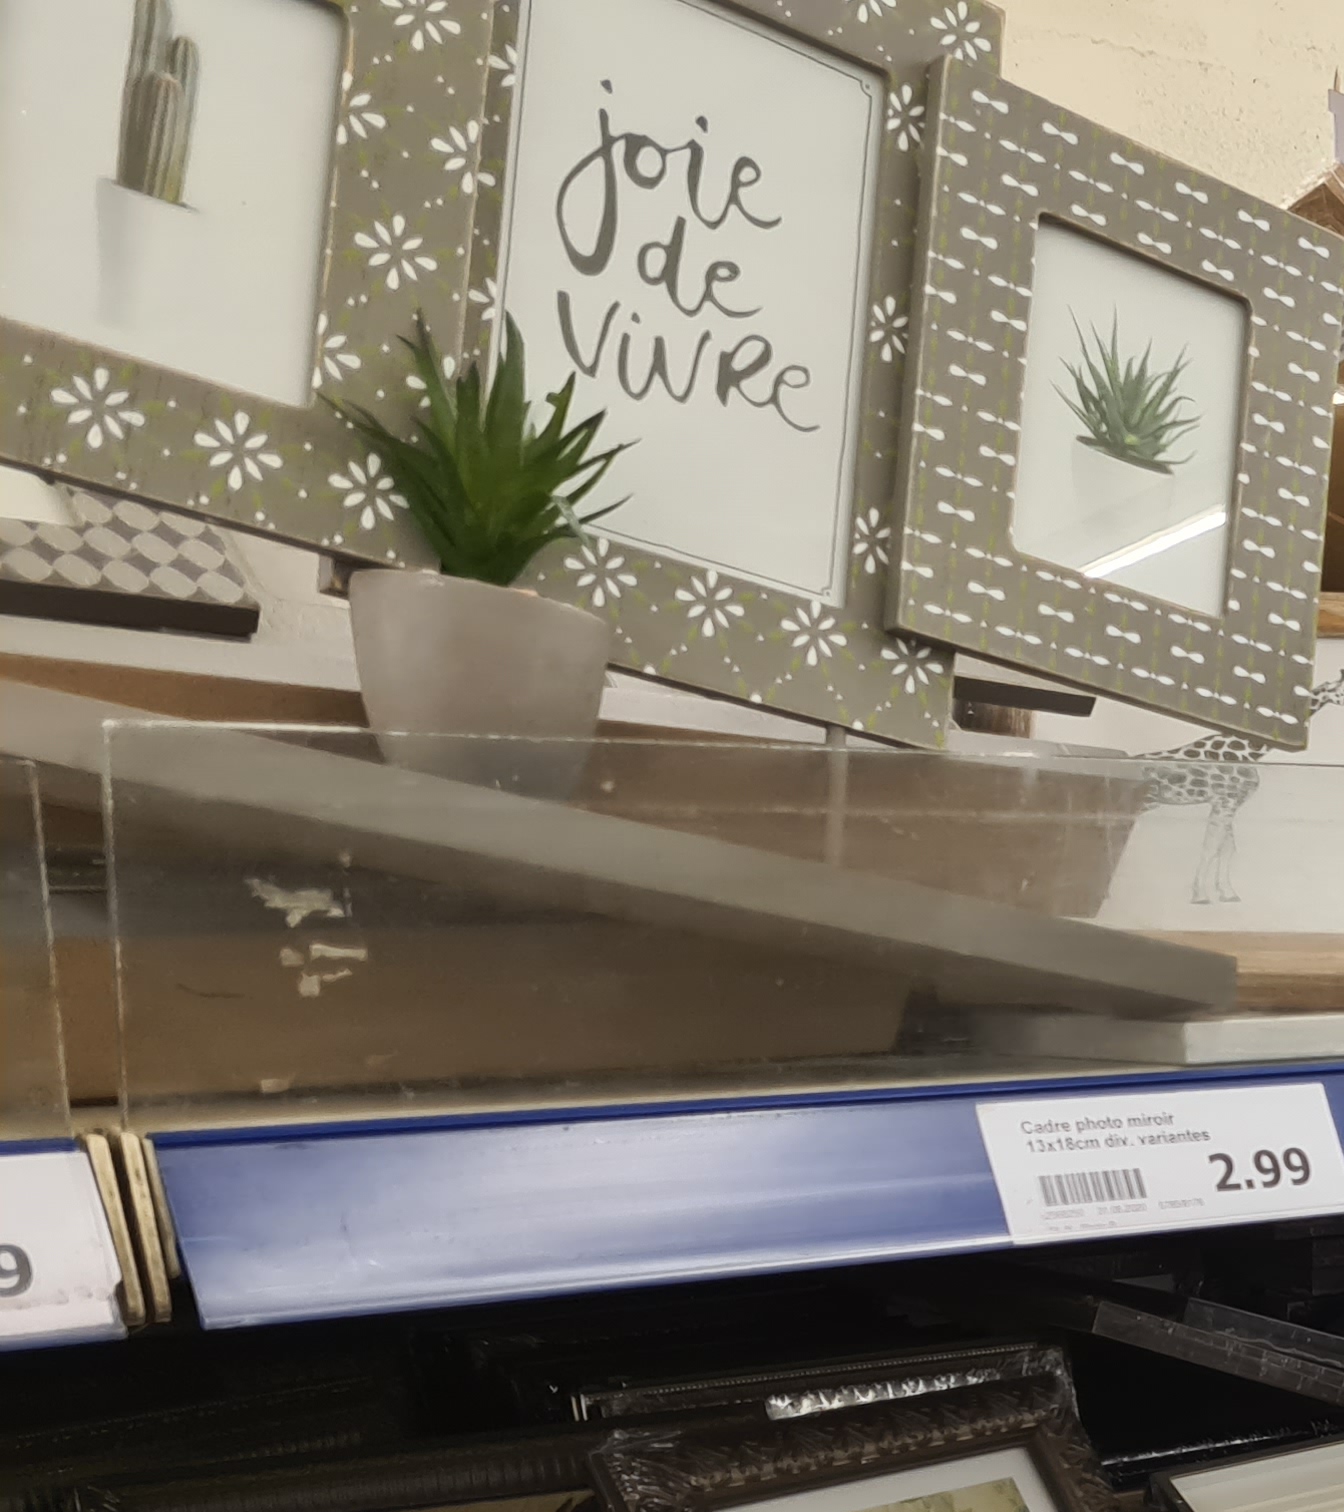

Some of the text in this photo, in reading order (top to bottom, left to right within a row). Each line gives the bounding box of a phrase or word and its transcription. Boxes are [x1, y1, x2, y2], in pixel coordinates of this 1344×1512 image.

[555, 78, 783, 277] joie
[636, 216, 763, 318] de
[1020, 1112, 1175, 1136] Cadre photo miroir
[1026, 1137, 1100, 1153] 13x18cm
[1138, 1128, 1211, 1146] variantes
[1207, 1146, 1312, 1192] 2.99
